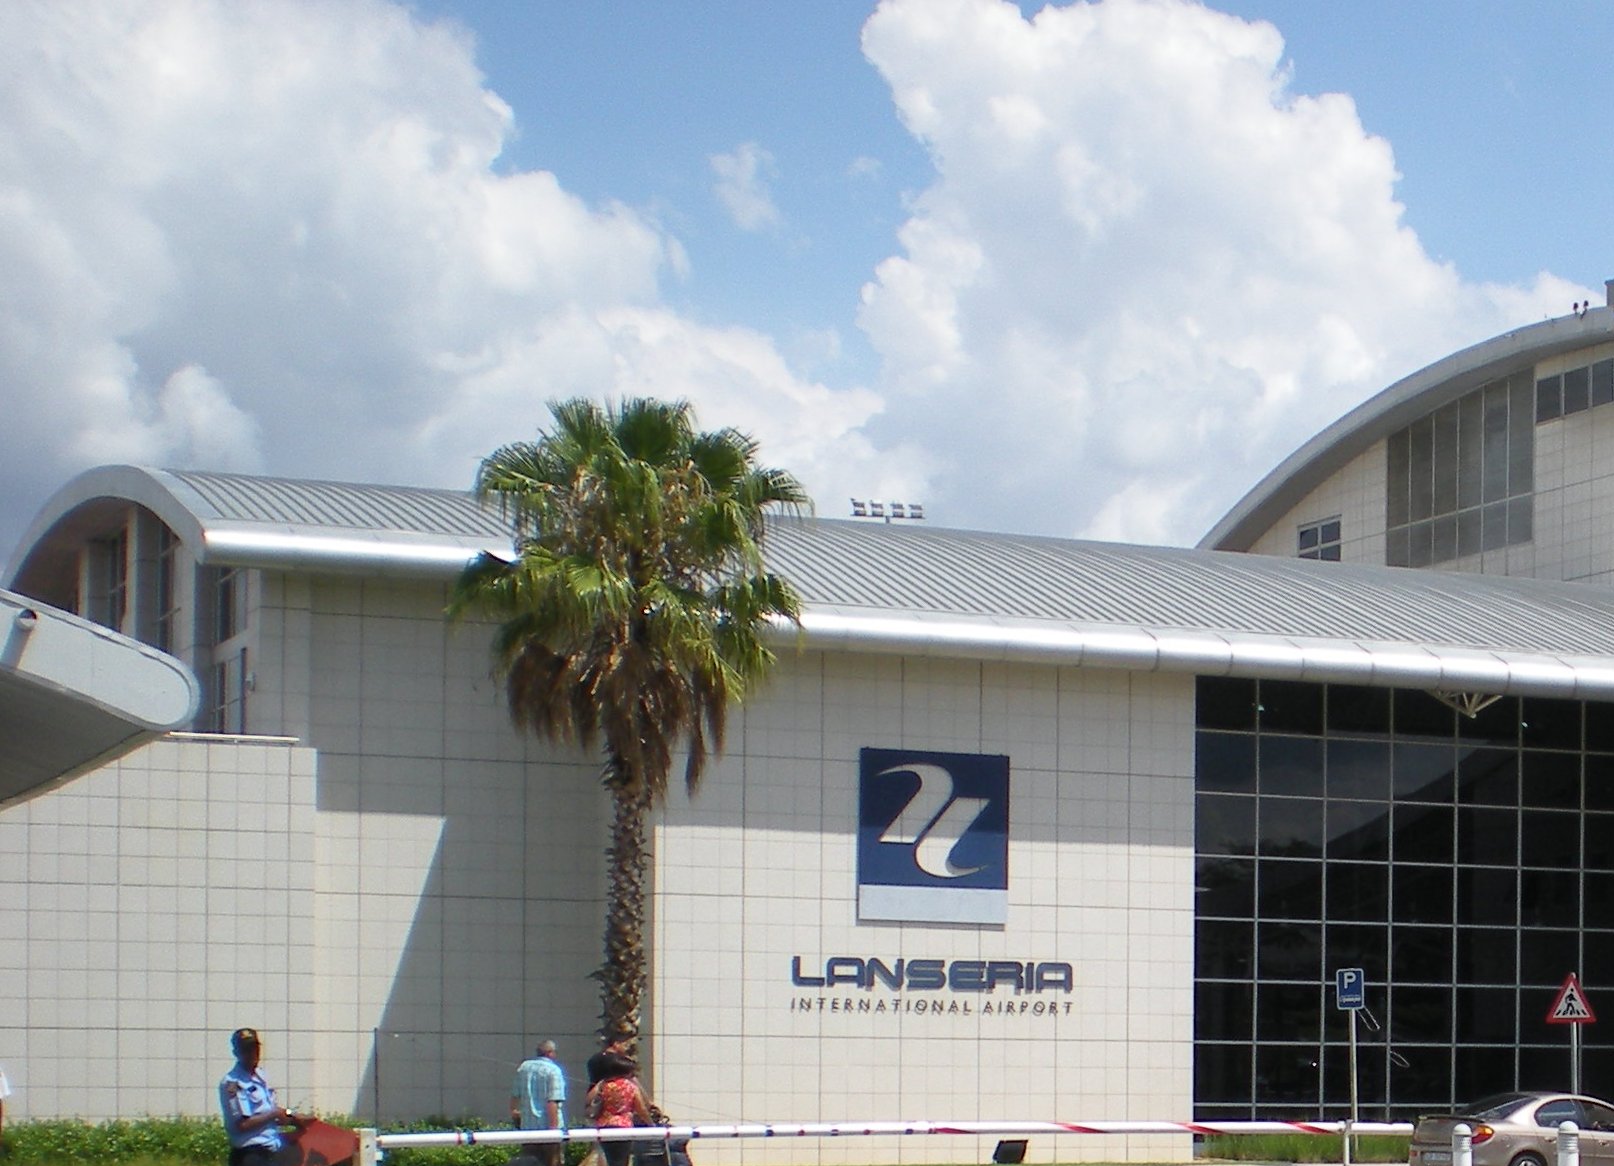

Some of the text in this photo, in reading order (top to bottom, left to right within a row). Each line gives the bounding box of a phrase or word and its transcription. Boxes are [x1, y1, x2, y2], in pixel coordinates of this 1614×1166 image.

[791, 956, 1073, 994] LANSERIA
[1343, 971, 1357, 990] P
[790, 997, 1074, 1017] INTERNATIONAL AIRPORT
